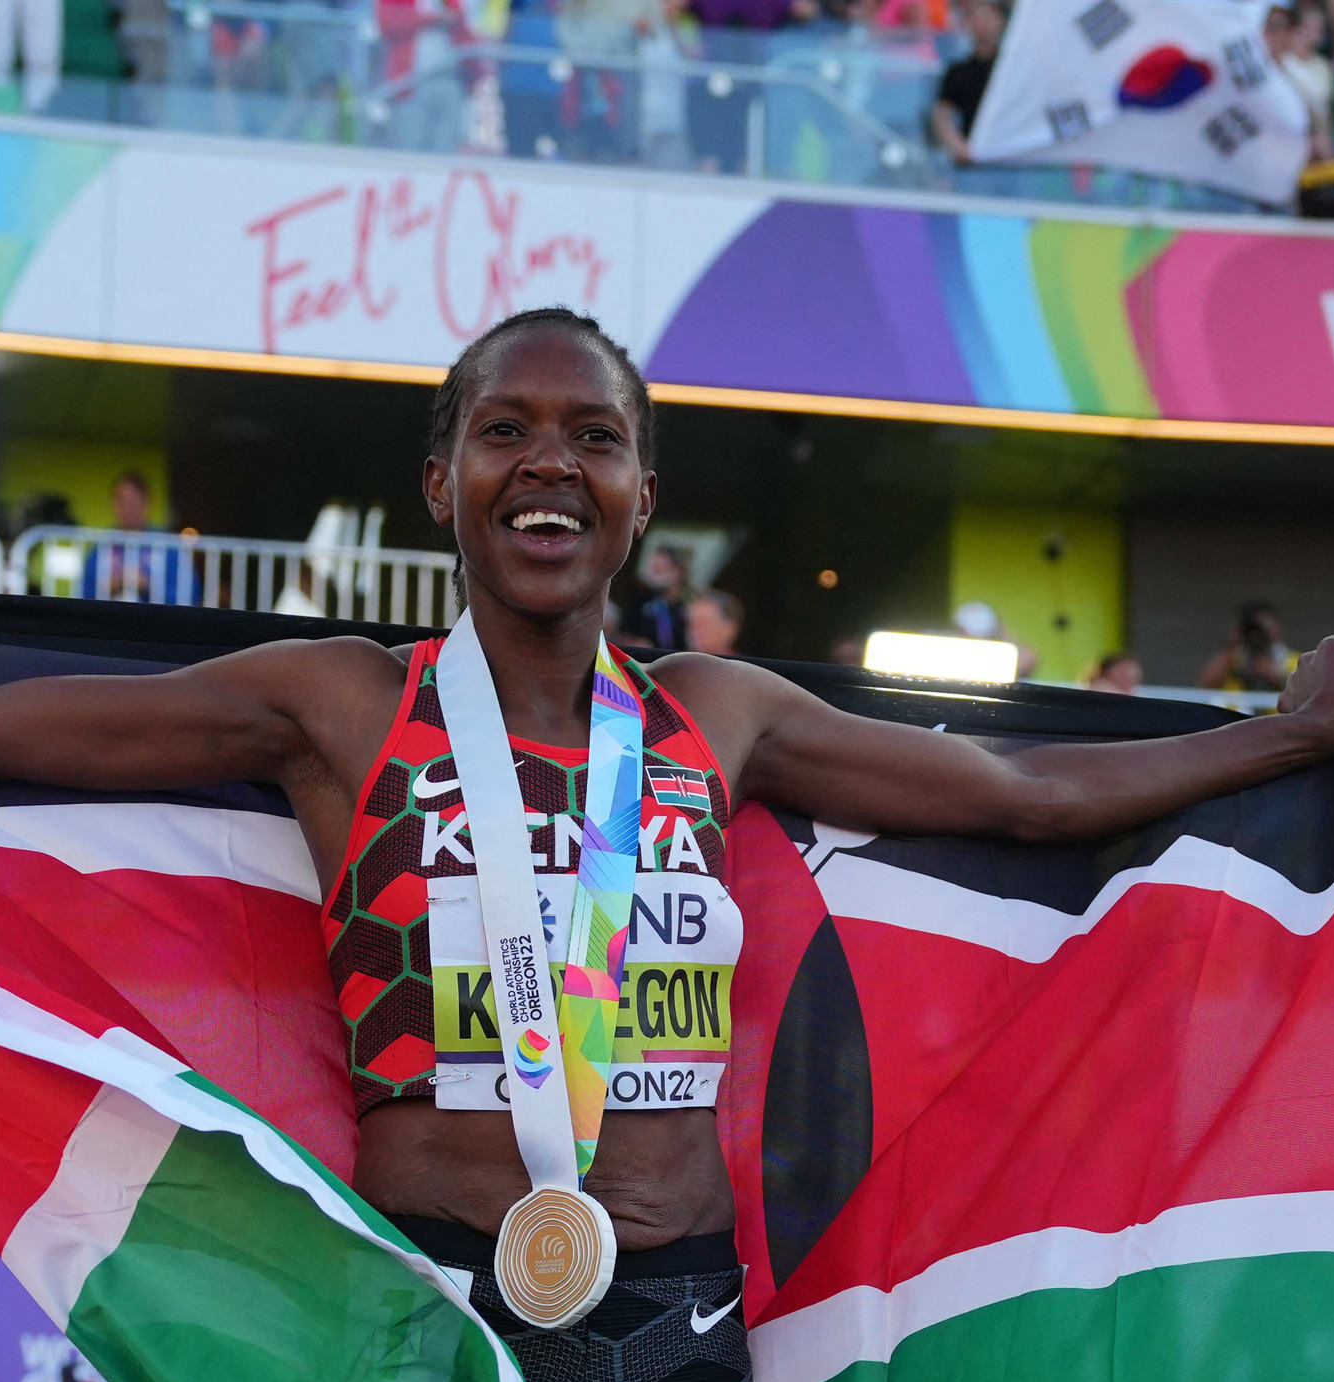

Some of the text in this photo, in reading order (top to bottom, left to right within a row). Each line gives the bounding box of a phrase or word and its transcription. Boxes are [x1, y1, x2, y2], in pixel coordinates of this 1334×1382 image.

[247, 183, 396, 353] Feel
[630, 893, 708, 945] NB
[457, 969, 721, 1039] KEGON
[500, 937, 520, 1025] WORLD ATHLETICS
[509, 936, 530, 1023] CHAMPIONSHIPS
[519, 934, 543, 1021] OREGON22
[495, 1069, 694, 1103] OON22
